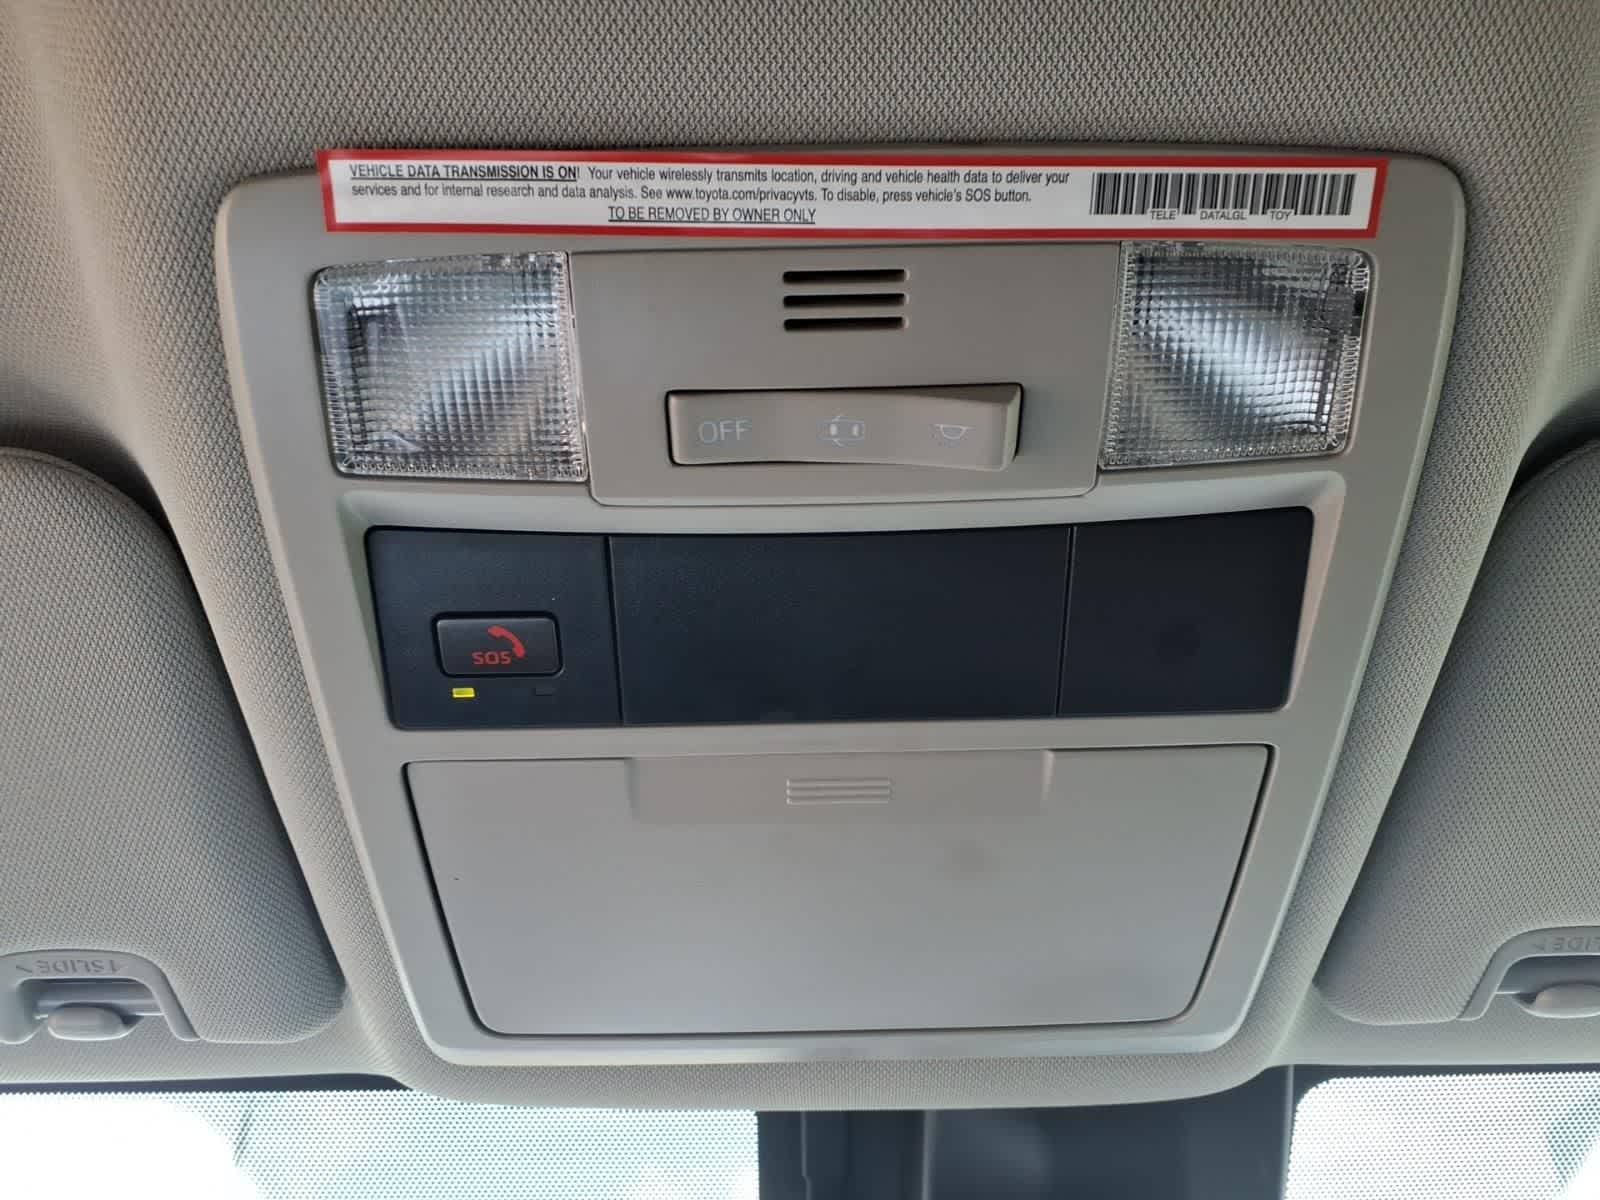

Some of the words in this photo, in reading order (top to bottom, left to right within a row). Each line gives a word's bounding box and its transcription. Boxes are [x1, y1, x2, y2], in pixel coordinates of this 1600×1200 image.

[350, 164, 403, 178] VEHICLE
[408, 165, 440, 178] DATA
[443, 165, 539, 179] TRANSMISSION
[543, 166, 554, 179] IS
[558, 166, 580, 179] ON!
[588, 167, 613, 180] Your
[617, 167, 655, 180] vehicle
[659, 168, 712, 184] wirelessly
[716, 168, 767, 182] transmits
[771, 169, 817, 184] location,
[821, 169, 858, 185] driving
[861, 170, 882, 183] and
[885, 170, 923, 183] vehicle
[927, 170, 960, 183] health
[964, 170, 988, 184] data
[991, 171, 1002, 184] to
[1006, 171, 1041, 184] deliver
[1045, 172, 1070, 187] your
[352, 183, 397, 196] services
[400, 183, 421, 196] and
[425, 184, 438, 196] for
[442, 184, 483, 197] internal
[486, 185, 534, 198] research
[538, 185, 558, 198] and
[562, 185, 586, 198] data
[589, 185, 637, 200] analysis.
[641, 186, 663, 199] See
[666, 187, 818, 204] www.toyota.com/privacyvts.
[821, 188, 834, 201] To
[836, 188, 880, 203] disable,
[882, 191, 913, 204] press
[915, 188, 962, 201] vehicle's
[965, 189, 991, 201] SOS
[995, 189, 1032, 201] button.
[608, 207, 625, 220] TO
[629, 207, 644, 220] BE
[649, 207, 710, 221] REMOVED
[713, 208, 729, 221] BY
[732, 208, 780, 222] OWNER
[784, 208, 816, 222] ONLY
[1150, 210, 1177, 221] TELE
[1269, 210, 1292, 221] TOY
[699, 420, 748, 444] OFF
[472, 651, 512, 665] SOS
